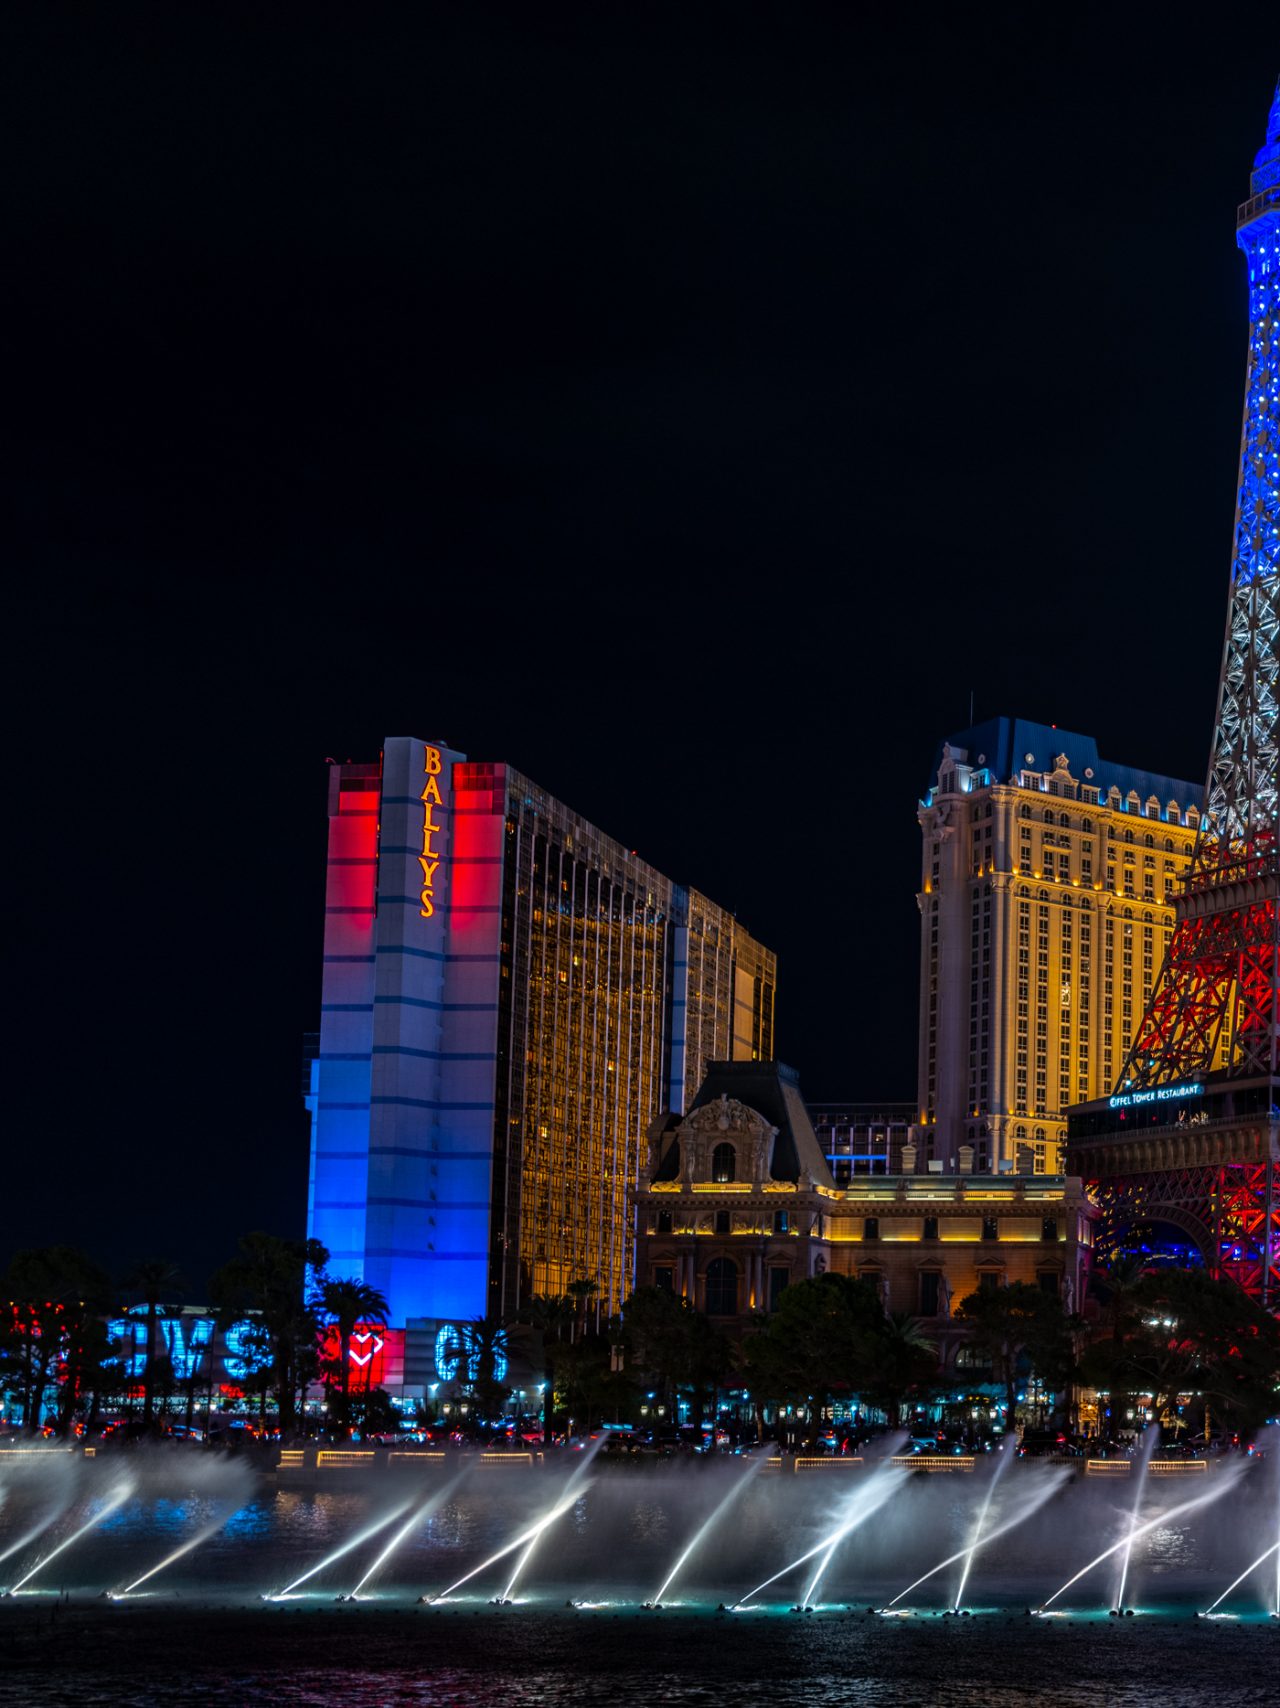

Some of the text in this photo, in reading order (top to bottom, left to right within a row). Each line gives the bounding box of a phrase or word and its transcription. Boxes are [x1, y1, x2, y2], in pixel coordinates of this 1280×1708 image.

[418, 745, 443, 917] BALLYS
[1109, 1085, 1199, 1108] EIFFEL TOWER RESTAURANT
